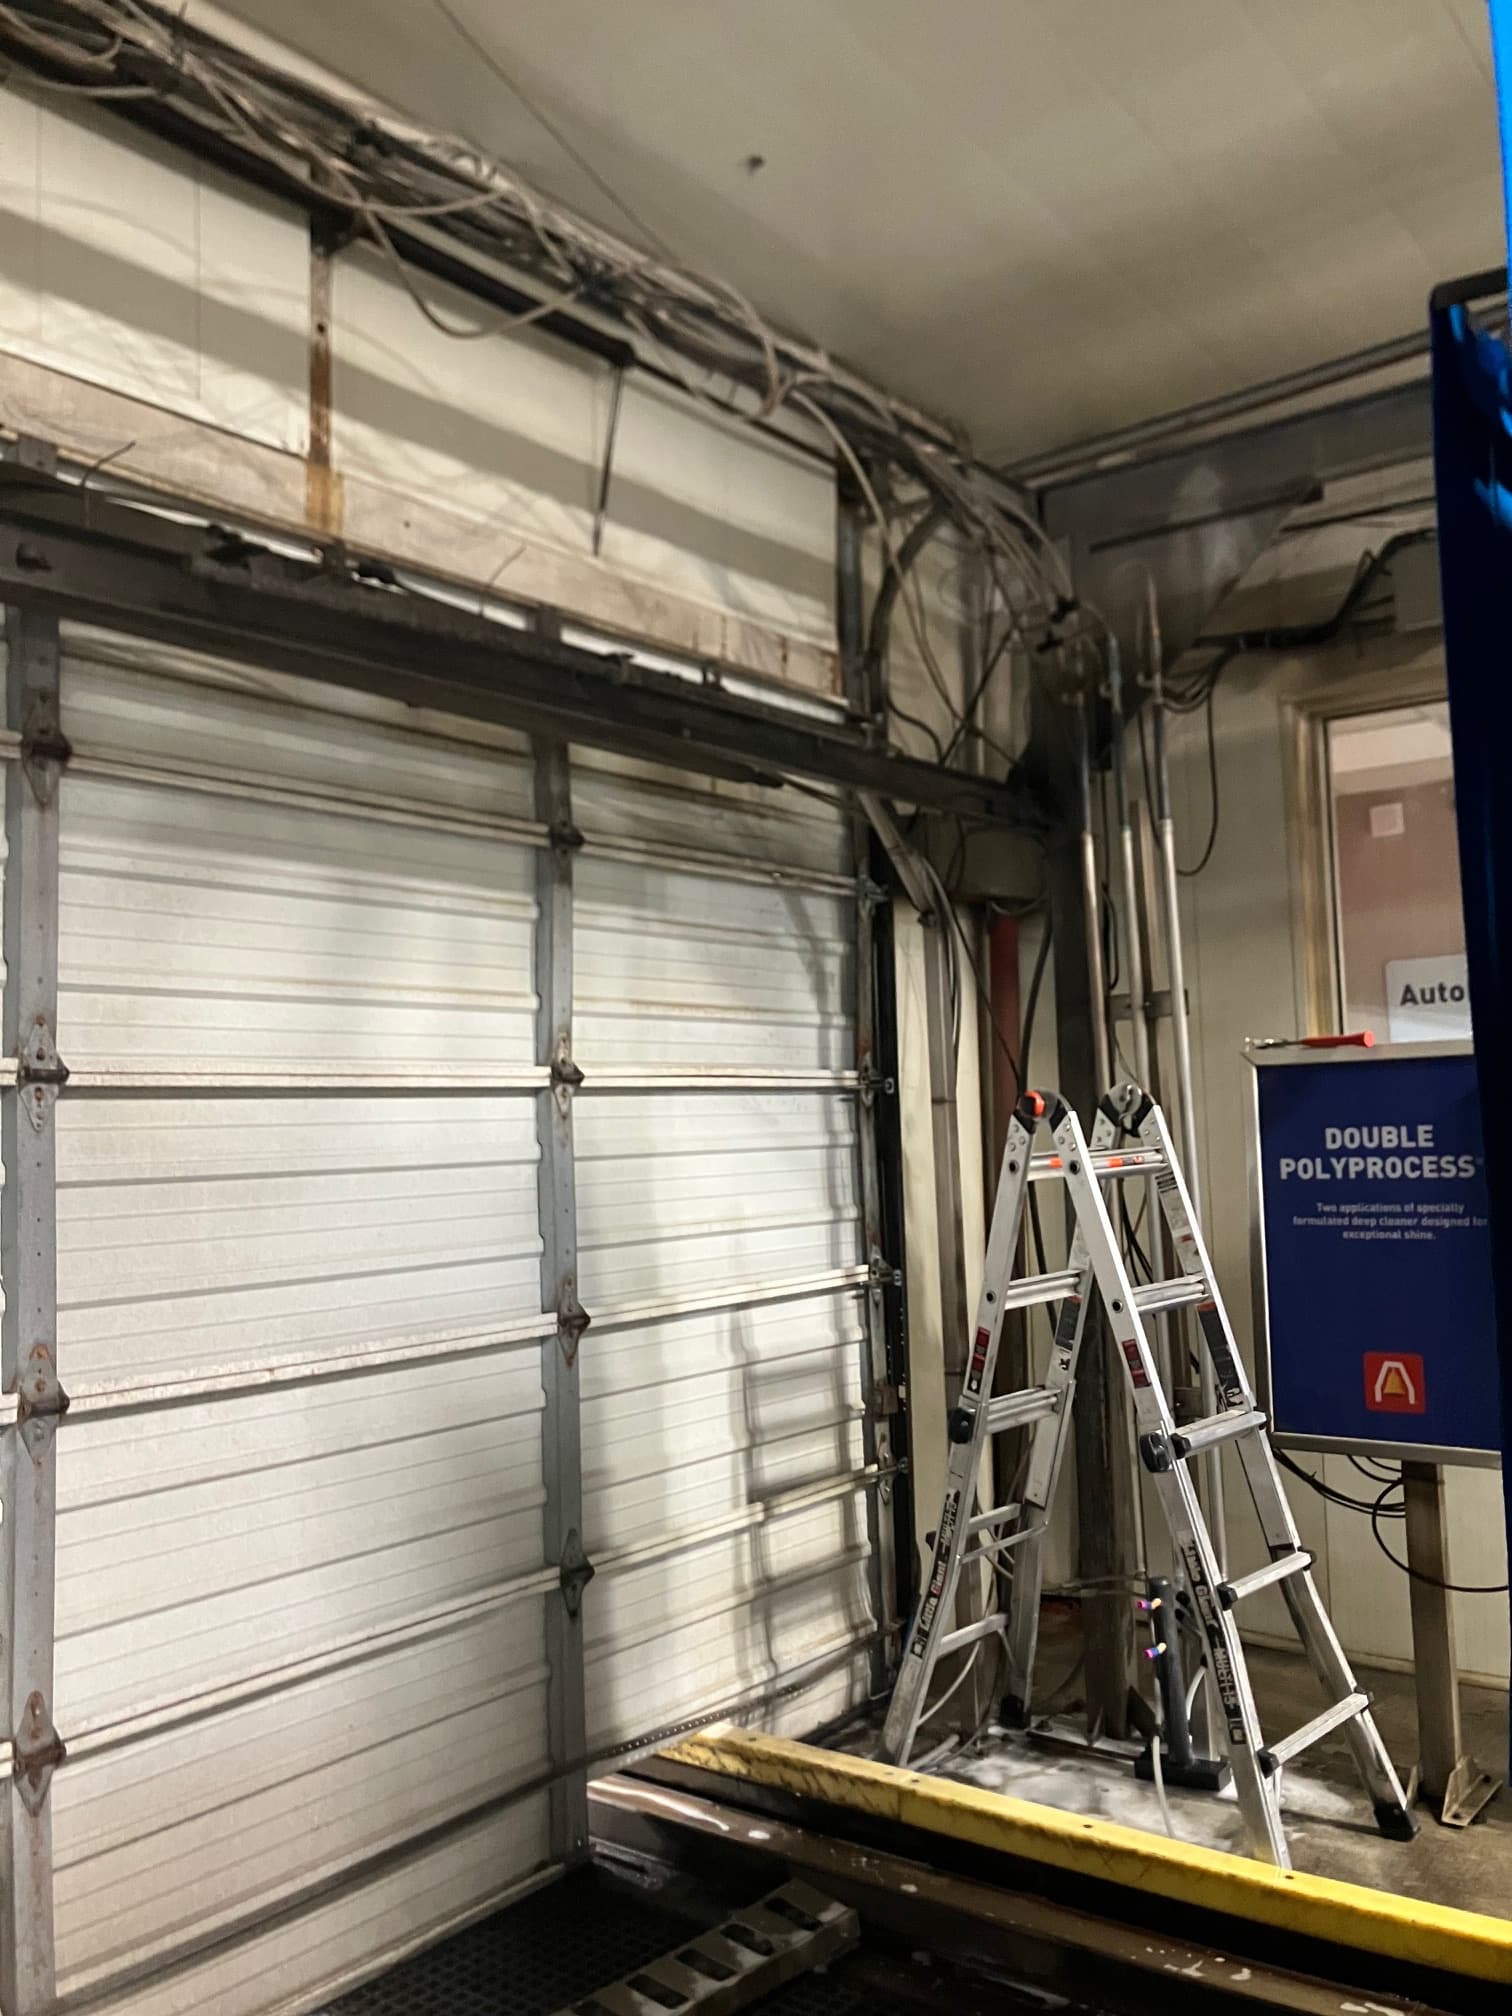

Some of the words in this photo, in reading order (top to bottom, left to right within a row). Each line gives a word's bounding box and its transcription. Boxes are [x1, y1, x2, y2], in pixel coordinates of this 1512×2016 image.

[1400, 982, 1465, 1006] Auto
[1325, 1125, 1434, 1149] DOUBLE
[1280, 1155, 1476, 1180] POLYPROCESS
[1316, 1203, 1337, 1213] Two
[1339, 1202, 1402, 1214] applications
[1403, 1202, 1414, 1213] of
[1416, 1202, 1465, 1214] specially
[1293, 1216, 1349, 1226] formulated
[1351, 1216, 1377, 1228] deep
[1379, 1216, 1418, 1227] cleaner
[1420, 1216, 1470, 1229] designed
[1472, 1216, 1488, 1227] for
[1342, 1229, 1401, 1241] exceptional
[1404, 1229, 1436, 1240] shine.
